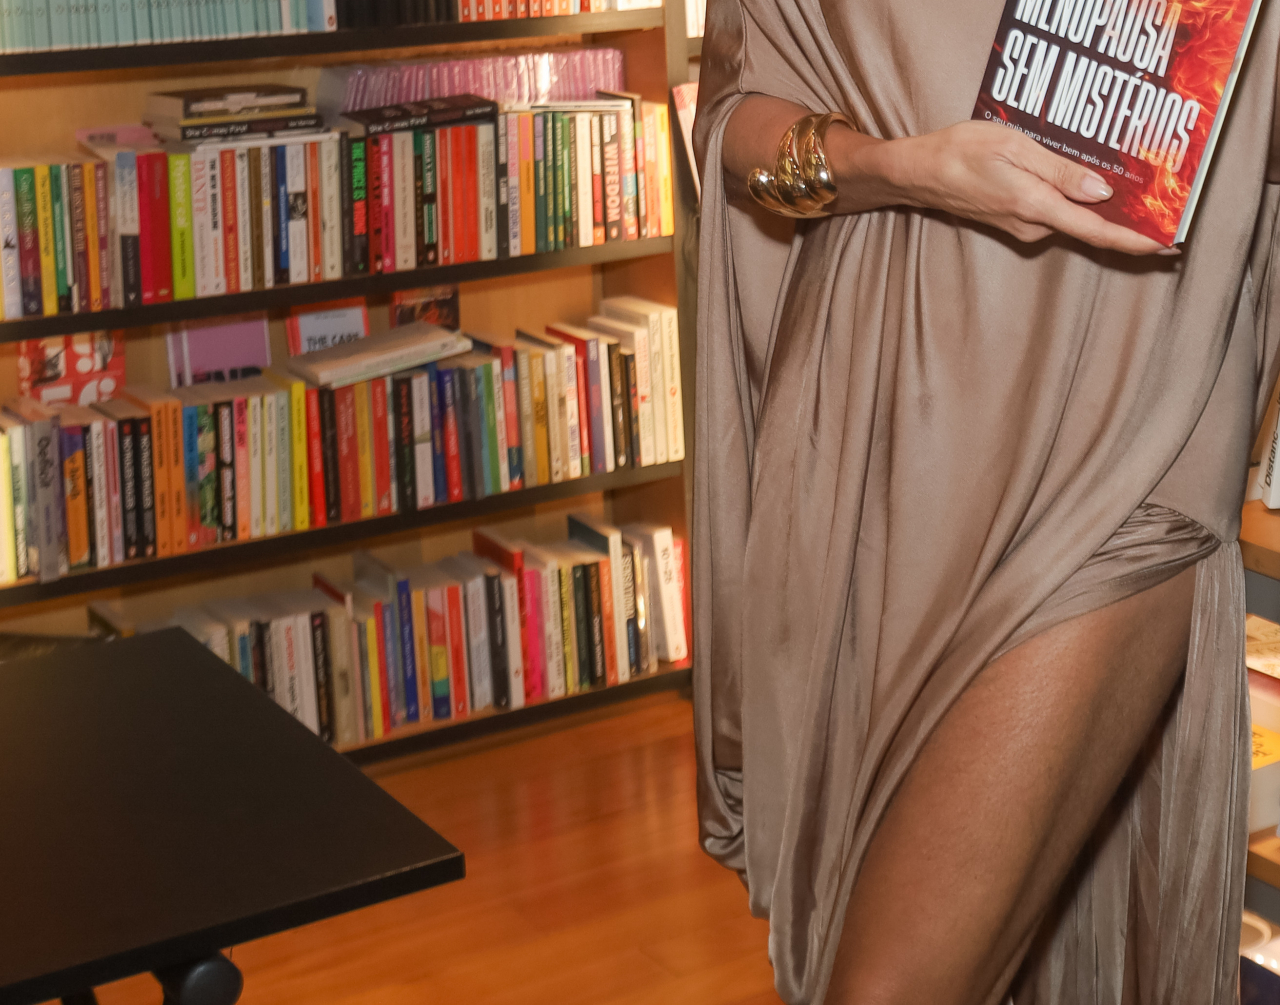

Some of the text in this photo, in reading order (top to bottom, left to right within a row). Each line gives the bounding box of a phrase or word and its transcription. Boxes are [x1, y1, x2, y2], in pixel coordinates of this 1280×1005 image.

[990, 28, 1200, 174] SEM MISTÉRIOS
[353, 142, 366, 235] THE PRICE IS WRONG
[604, 143, 621, 222] WIFEDOM
[984, 111, 992, 119] O
[1042, 136, 1062, 149] viver
[1062, 144, 1080, 157] bem
[1080, 152, 1100, 167] após
[1101, 161, 1112, 170] os
[1112, 164, 1124, 175] 50
[1124, 171, 1144, 183] anos
